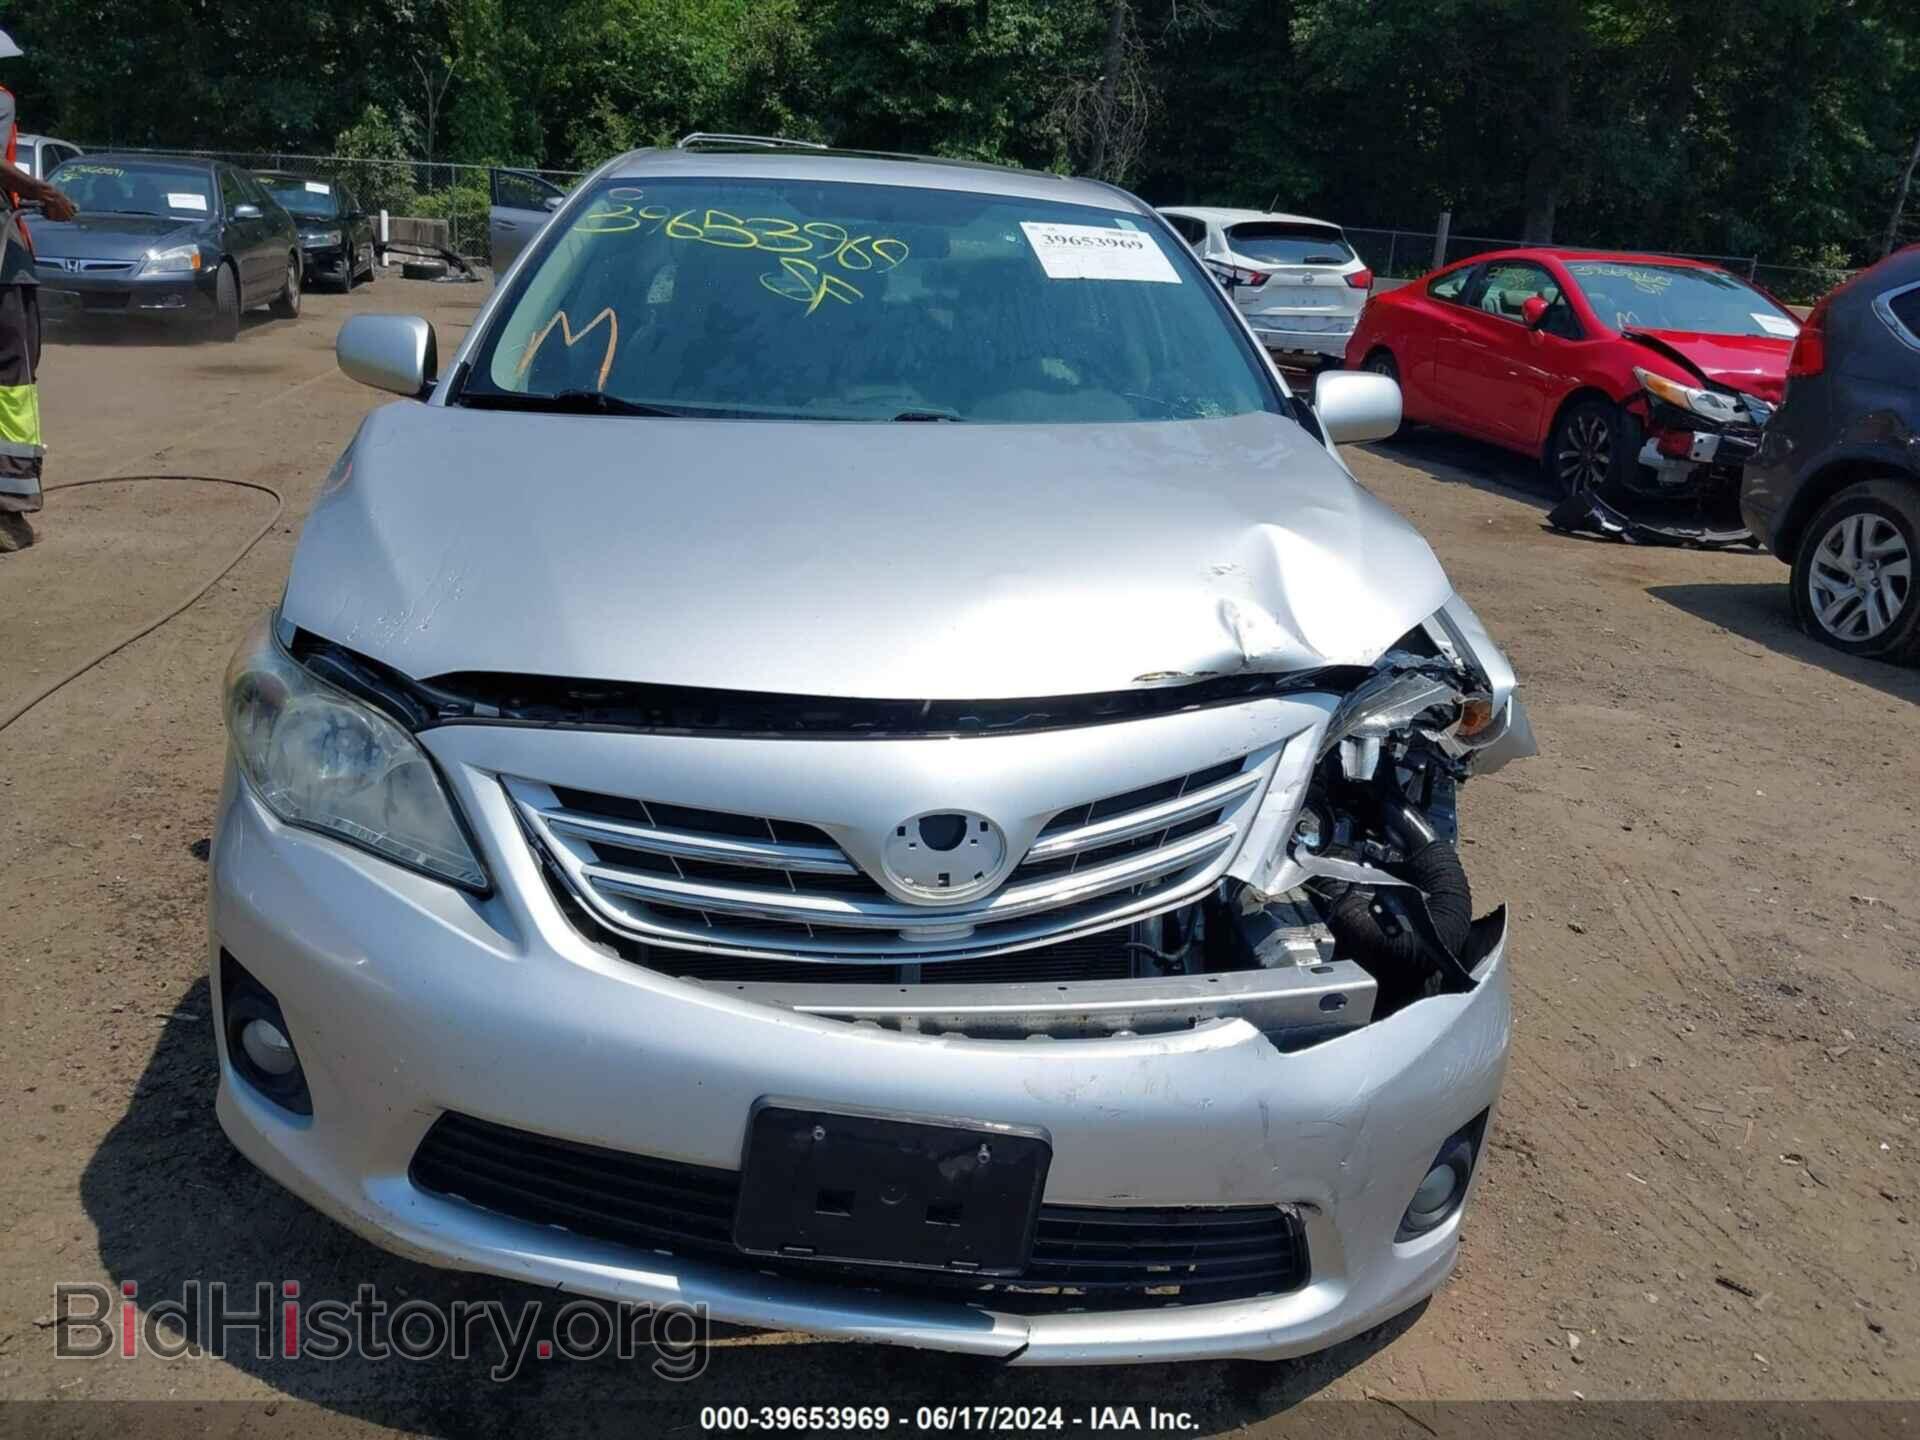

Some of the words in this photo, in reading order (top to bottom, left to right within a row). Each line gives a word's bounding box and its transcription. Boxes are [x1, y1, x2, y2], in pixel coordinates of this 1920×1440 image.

[573, 204, 909, 273] 39653969
[1042, 234, 1144, 250] 39653969
[515, 307, 618, 393] M
